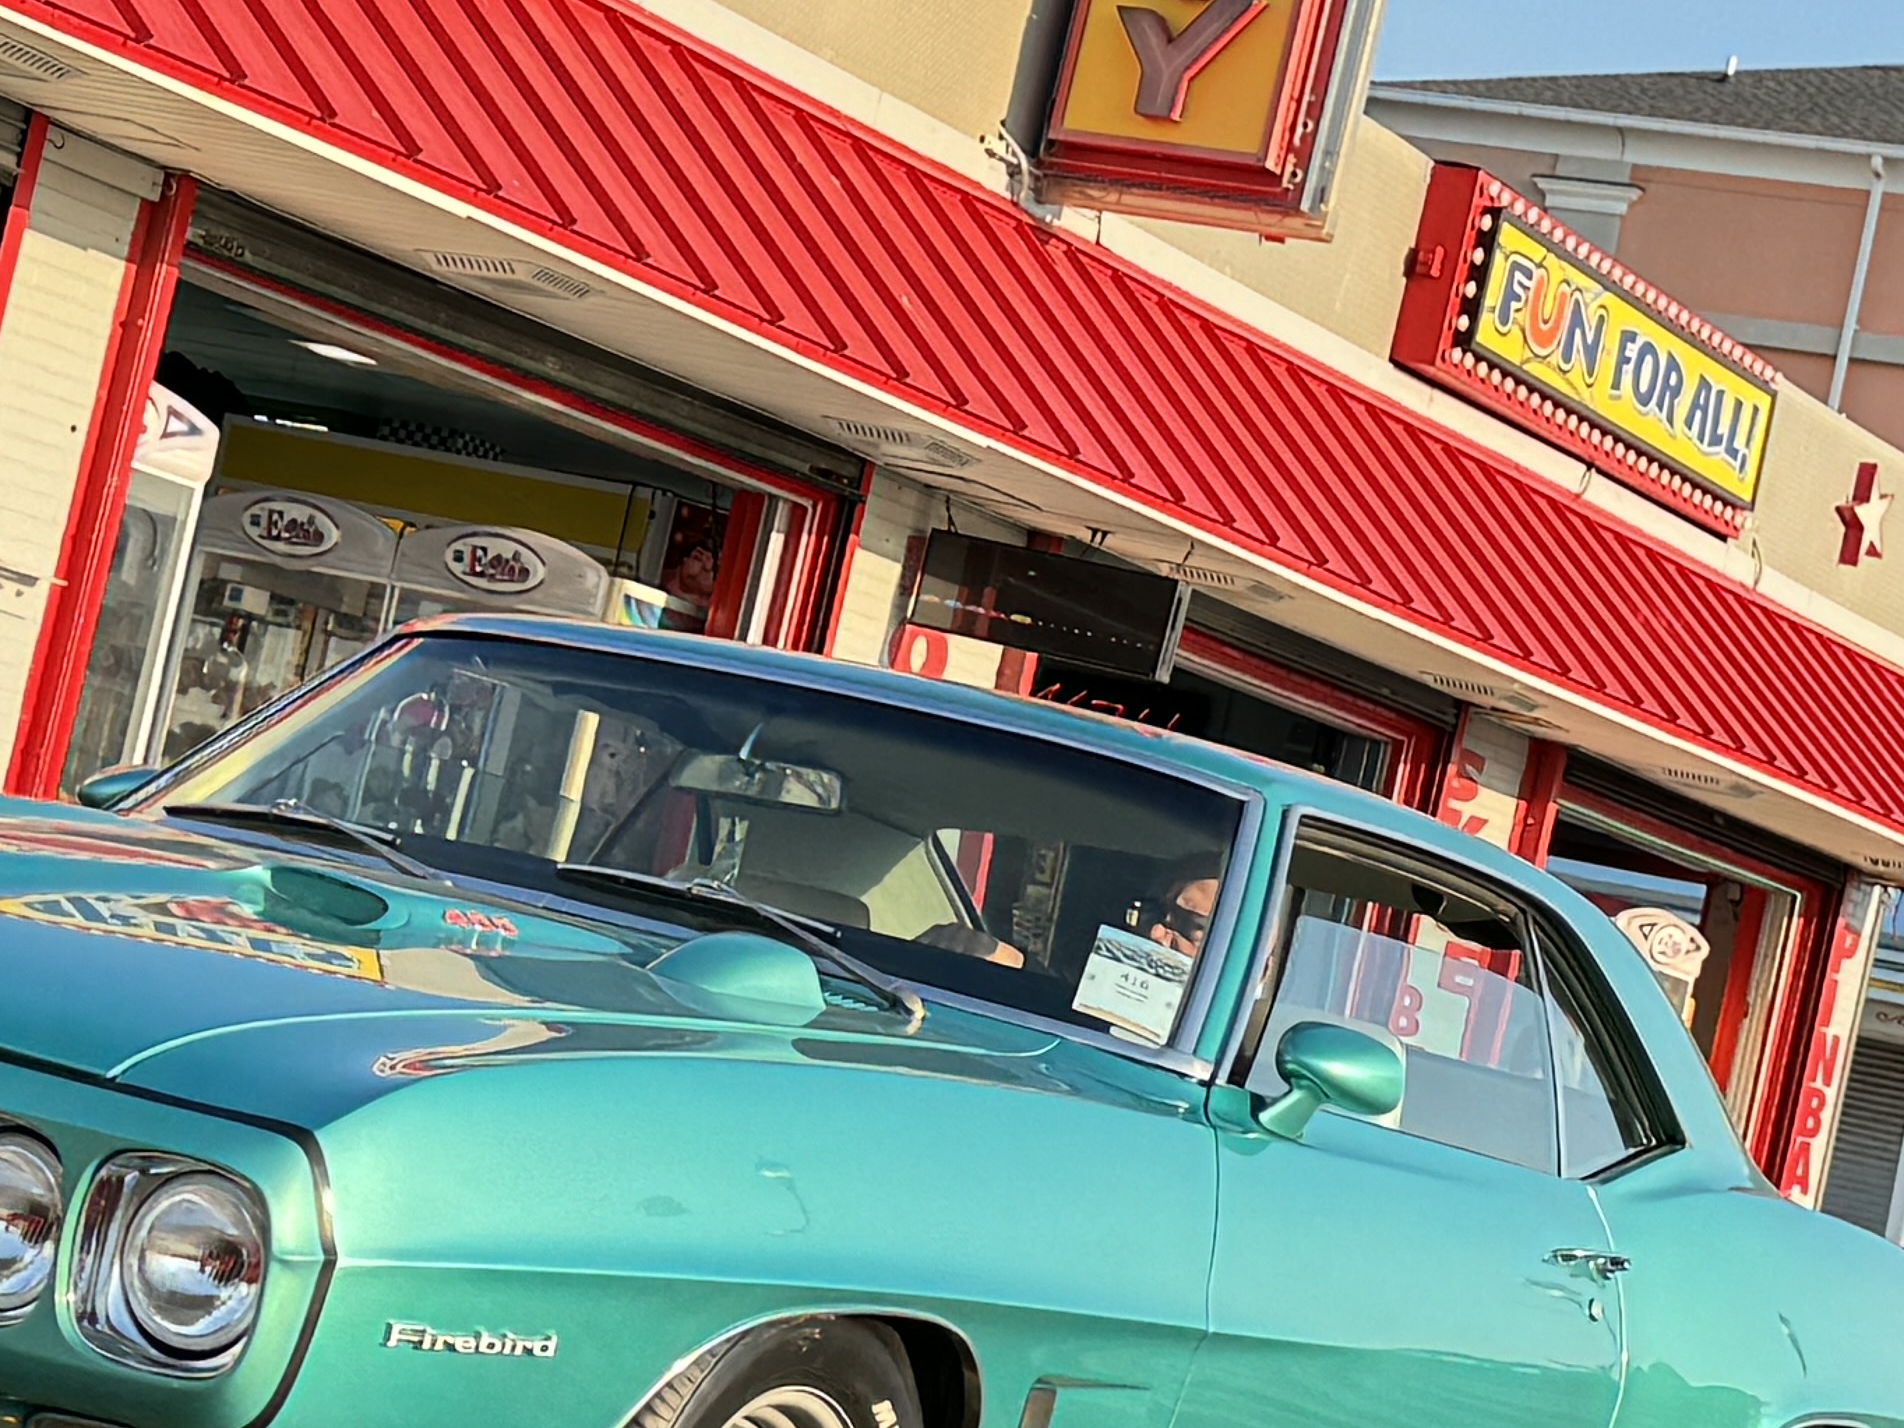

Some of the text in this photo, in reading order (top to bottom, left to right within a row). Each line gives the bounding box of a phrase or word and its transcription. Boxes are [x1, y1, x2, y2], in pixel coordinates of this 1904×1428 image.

[1494, 256, 1610, 384] FUN
[1610, 329, 1682, 431] FOR
[385, 1319, 559, 1359] Firebird
